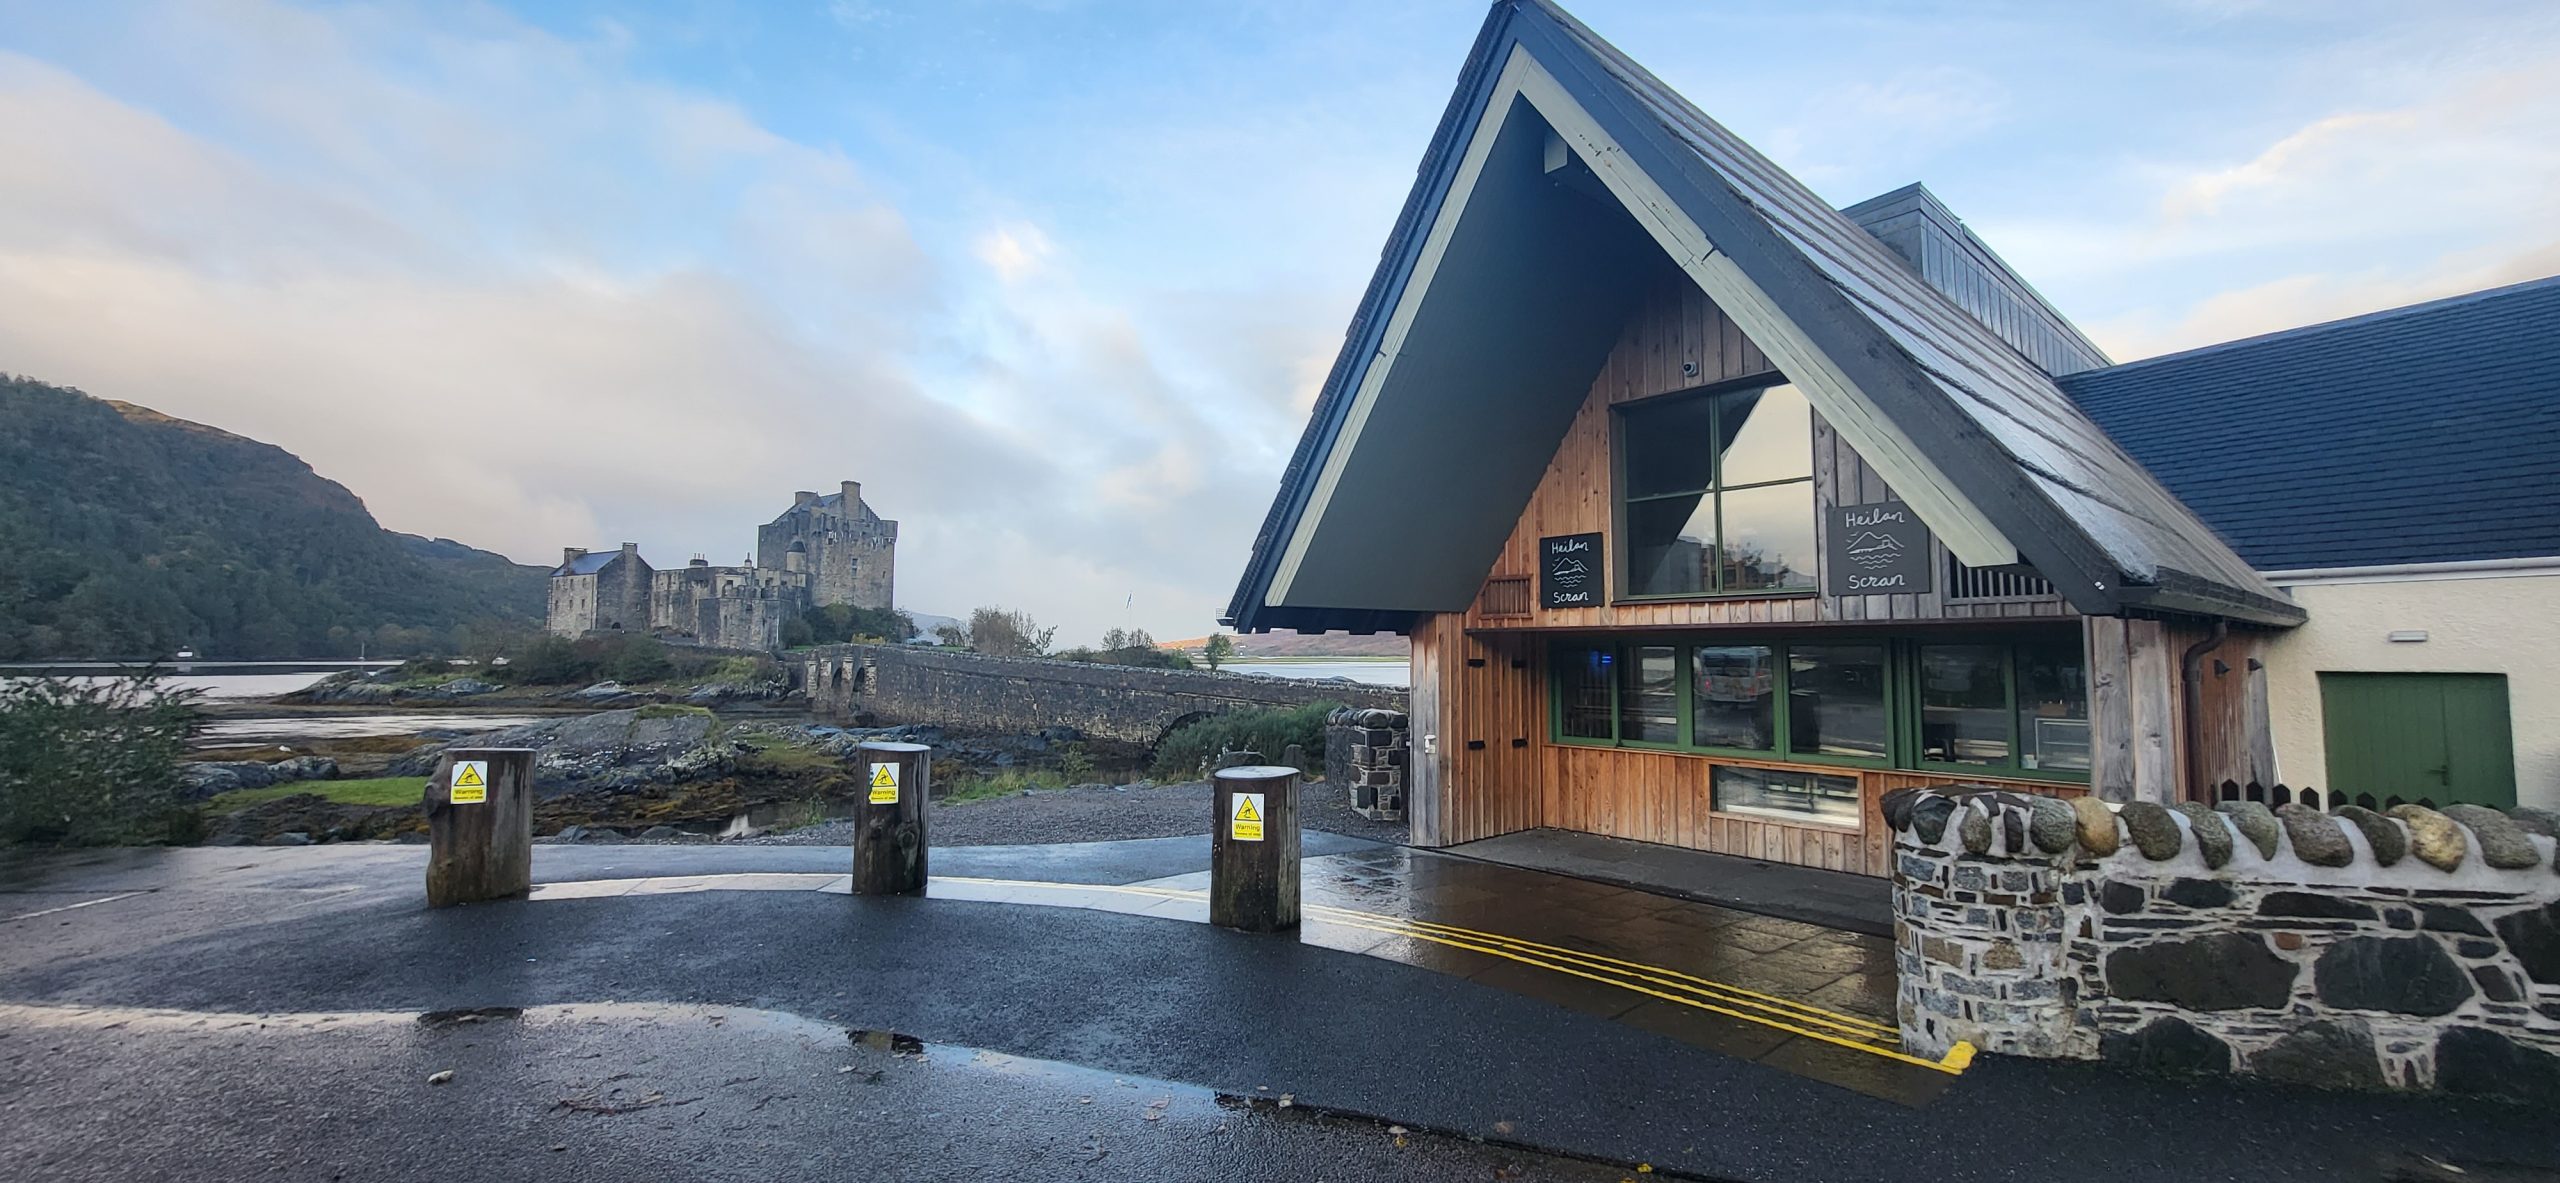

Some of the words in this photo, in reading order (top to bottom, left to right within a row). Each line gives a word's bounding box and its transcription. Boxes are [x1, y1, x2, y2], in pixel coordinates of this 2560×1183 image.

[1845, 508, 1905, 528] Heilan
[1551, 538, 1589, 554] Heilan
[1848, 574, 1906, 589] Scran
[1553, 591, 1589, 604] Scran
[1235, 823, 1261, 832] Warning
